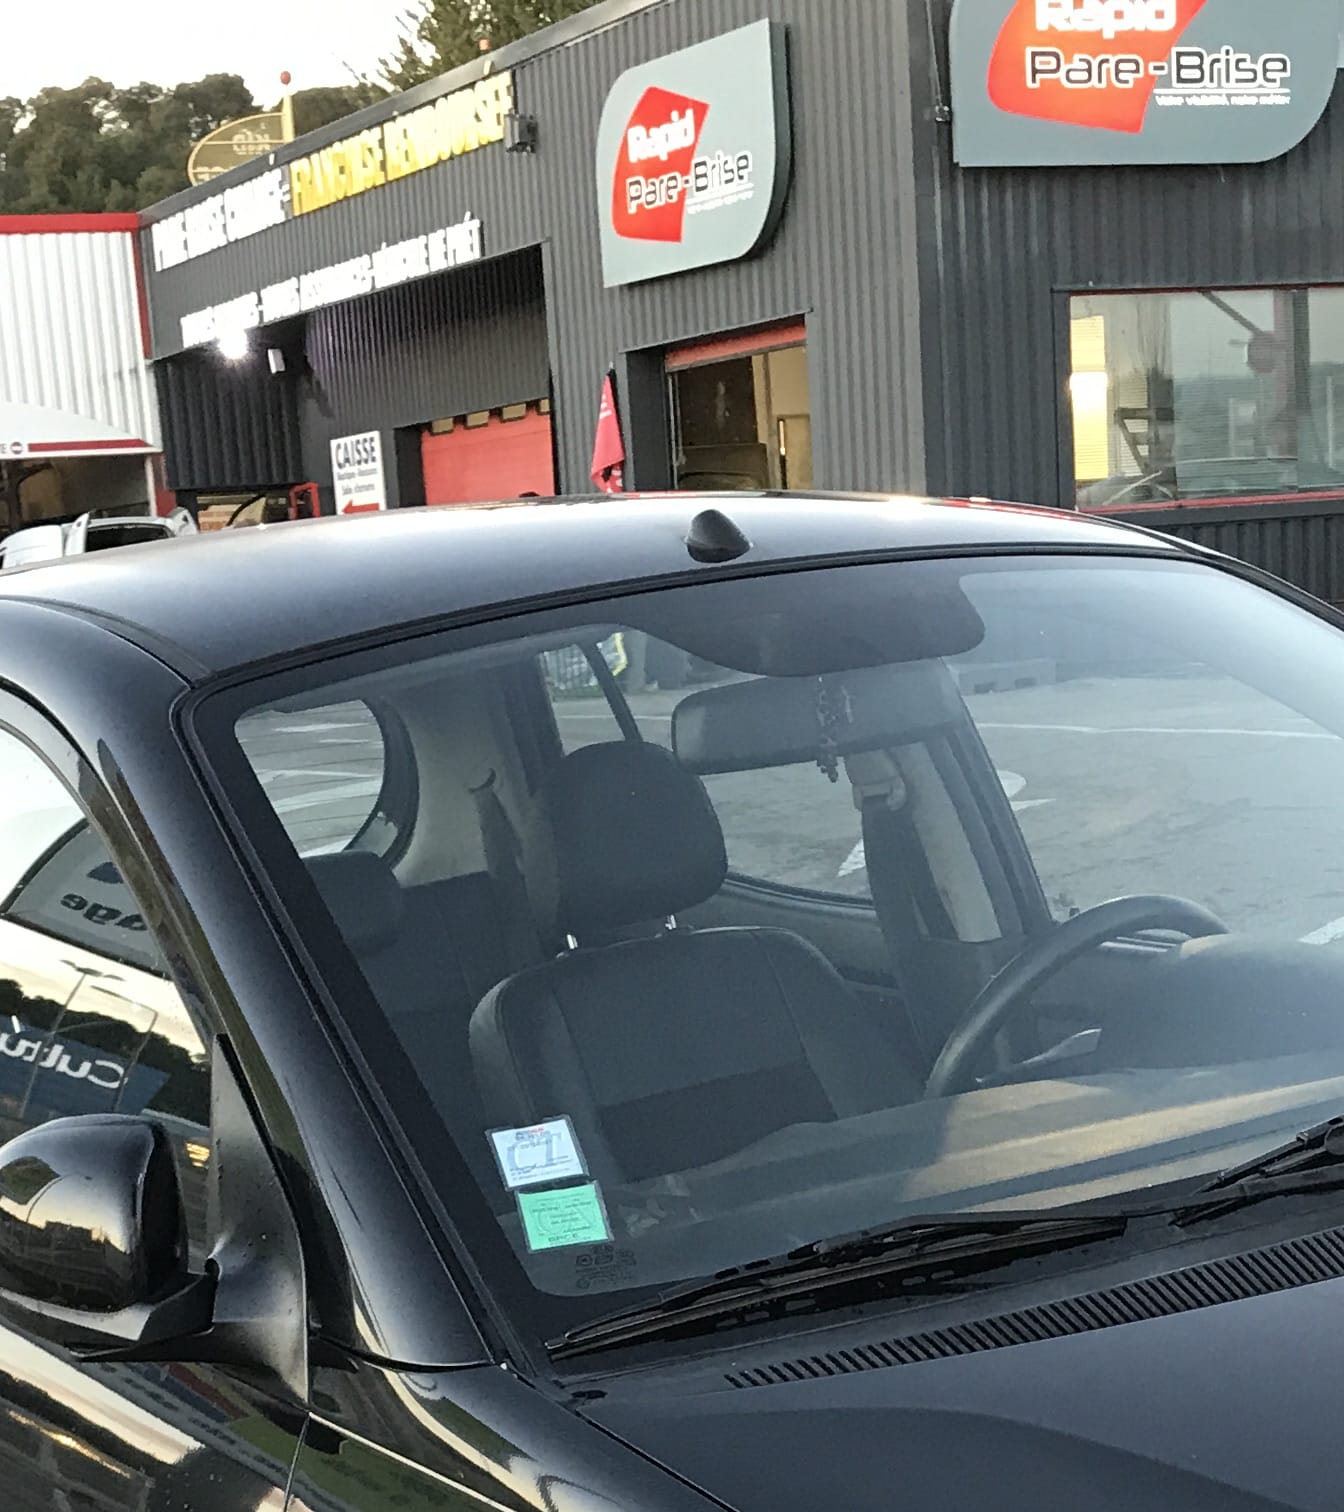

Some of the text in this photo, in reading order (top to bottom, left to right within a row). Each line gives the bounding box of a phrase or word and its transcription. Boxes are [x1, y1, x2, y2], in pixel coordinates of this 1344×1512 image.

[626, 108, 695, 163] Rapid
[625, 150, 753, 215] Pare-Brise
[335, 436, 377, 470] CAISSE
